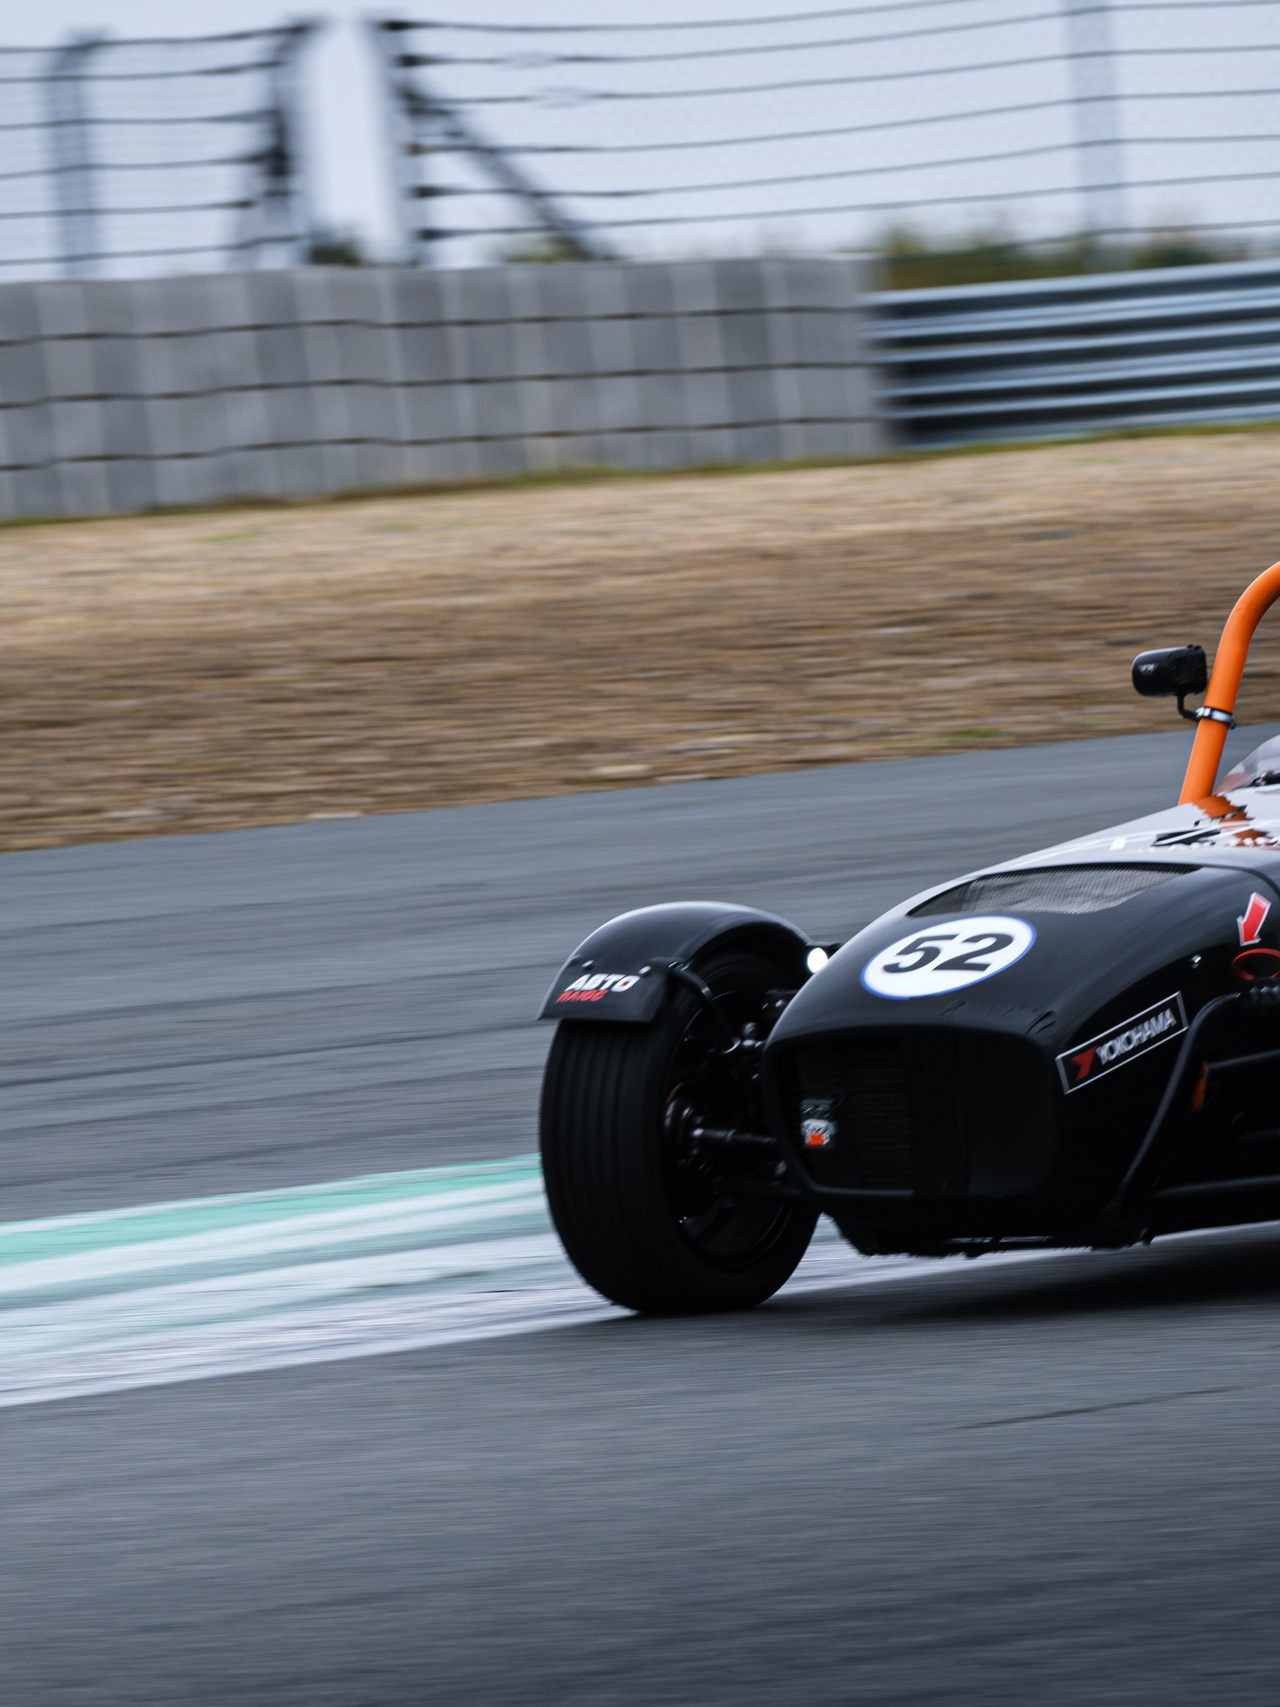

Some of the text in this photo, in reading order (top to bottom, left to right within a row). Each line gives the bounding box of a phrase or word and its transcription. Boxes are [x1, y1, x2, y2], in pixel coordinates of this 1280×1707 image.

[883, 933, 1014, 973] 52
[564, 973, 640, 992] АВТО
[1095, 1008, 1177, 1065] YOKOHAMA
